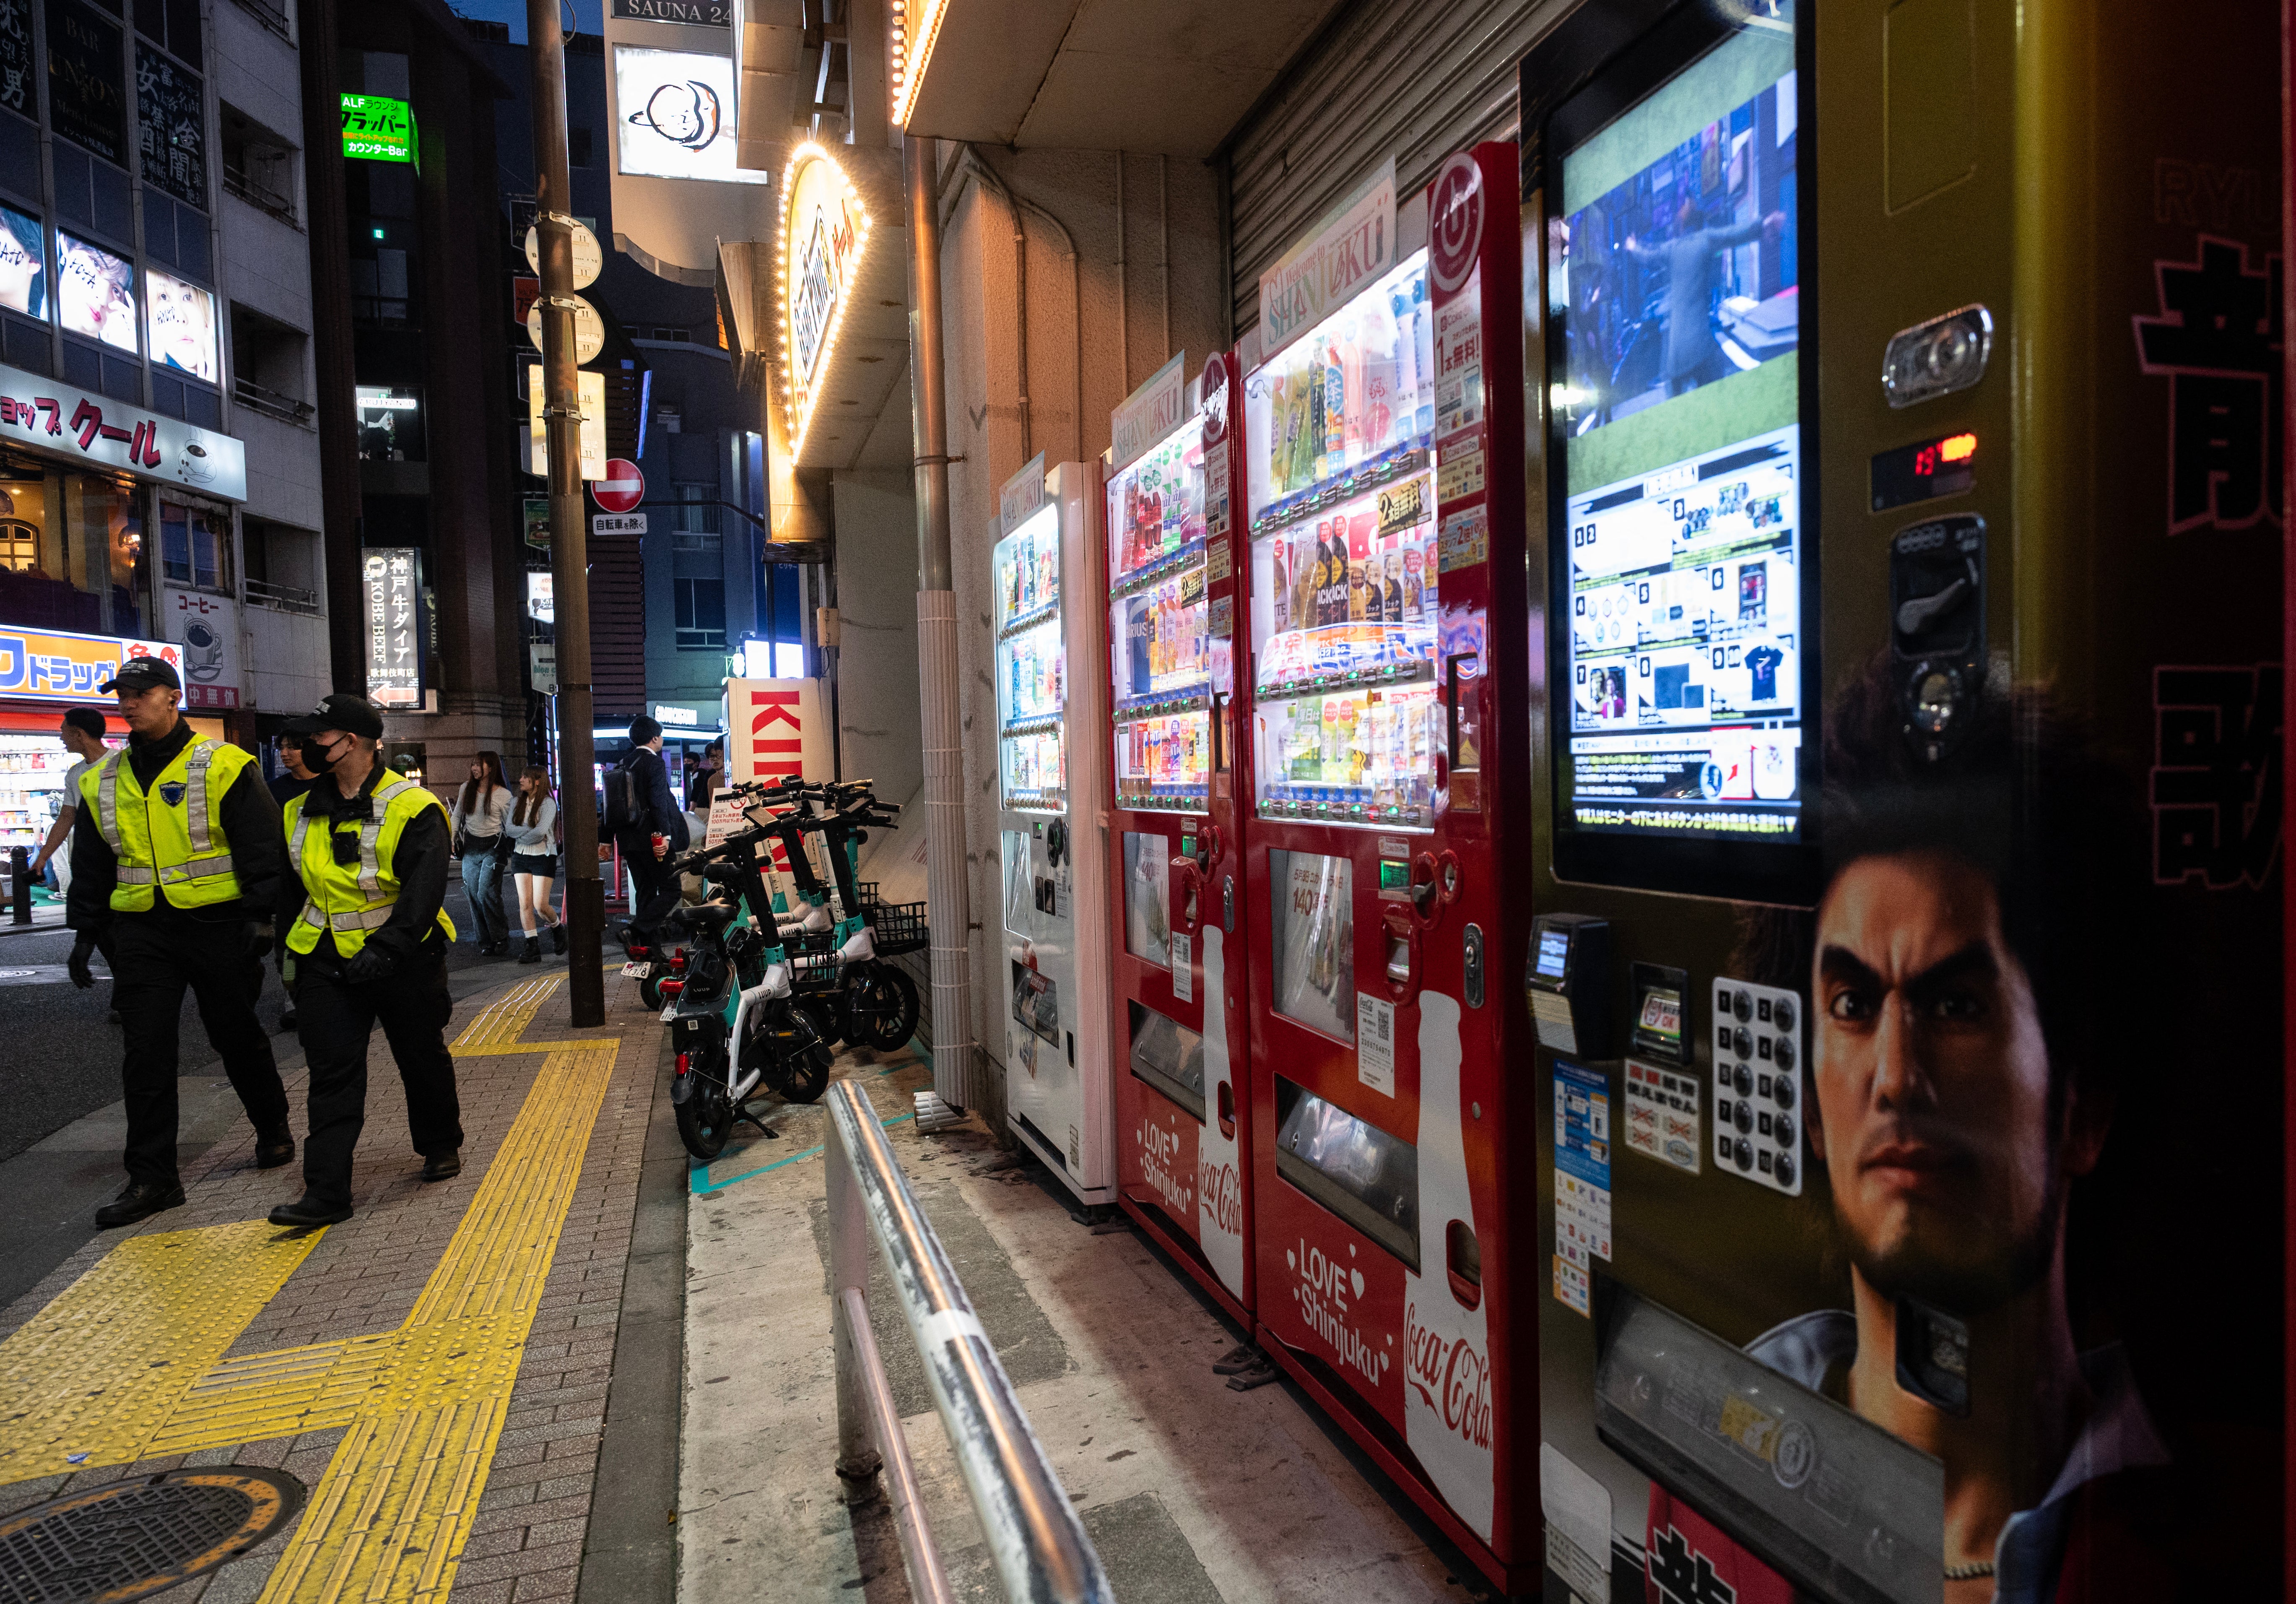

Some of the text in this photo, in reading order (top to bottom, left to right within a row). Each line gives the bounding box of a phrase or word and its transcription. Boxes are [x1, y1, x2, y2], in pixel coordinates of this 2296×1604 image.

[629, 0, 702, 21] SAUNA
[65, 15, 99, 53] BAR
[136, 60, 159, 101] 女
[175, 117, 200, 156] 金
[348, 142, 408, 156] カウンターBar
[69, 397, 162, 469] クール
[596, 518, 644, 530] 自転車を除く
[178, 595, 219, 614] コーヒー
[371, 581, 387, 664] KOBE BEEF
[390, 556, 410, 663] 神戸牛ダイア
[1127, 622, 1147, 638] ARIUS
[370, 668, 415, 678] 歌舞伎町店
[188, 686, 236, 706] 中無休
[758, 988, 771, 999] LUUP
[1145, 1118, 1170, 1167] LOVE
[1144, 1152, 1186, 1215] Shinjuku
[1198, 1146, 1242, 1237] Coca-Cola
[1301, 1237, 1347, 1313] LOVE
[1301, 1283, 1379, 1387] Shinjuku
[1405, 1302, 1492, 1451] Coca-Cola
